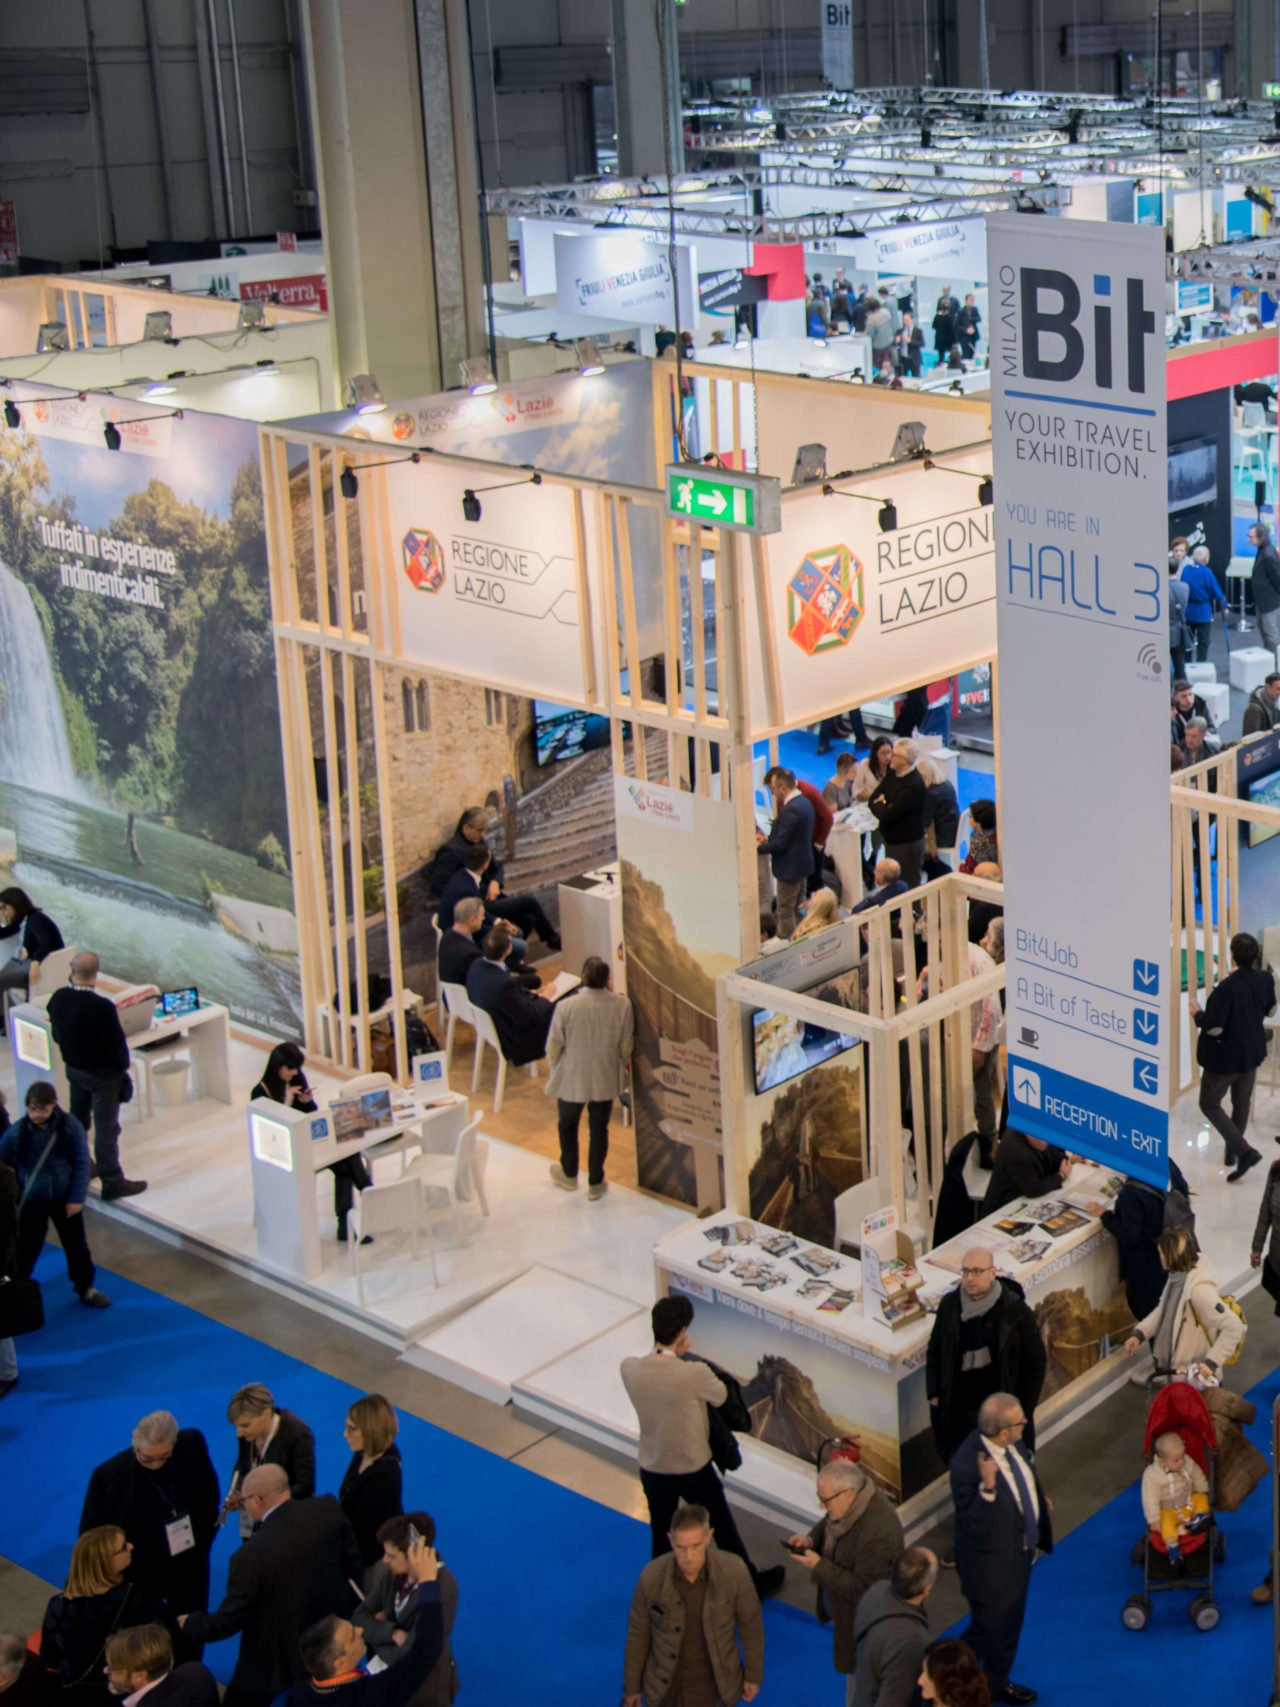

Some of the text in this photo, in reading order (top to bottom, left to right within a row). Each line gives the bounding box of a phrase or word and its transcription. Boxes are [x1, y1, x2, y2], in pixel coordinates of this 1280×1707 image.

[827, 4, 850, 26] Bit
[581, 279, 606, 298] FRIULI
[607, 271, 638, 292] VENEZIA
[639, 263, 666, 282] GIULIA
[1000, 265, 1018, 377] MILANO
[1020, 267, 1155, 393] Bit
[1004, 410, 1157, 453] YOUR TRAVEL
[1016, 439, 1147, 479] EXHIBITION.
[38, 516, 176, 575] Tuffati in esperienze
[877, 511, 996, 573] REGION
[1006, 502, 1099, 536] YOU ARE IN
[59, 556, 165, 609] indimenticabili.
[451, 540, 529, 577] REGIONE
[1008, 538, 1160, 622] HALL 3
[454, 574, 506, 604] LAZIO
[880, 572, 968, 625] LAZIO
[1016, 928, 1079, 969] Bit4Job
[1017, 977, 1127, 1035] A Bit of Taste
[1045, 1095, 1118, 1141] RECEPTION
[1131, 1128, 1162, 1157] EXIT
